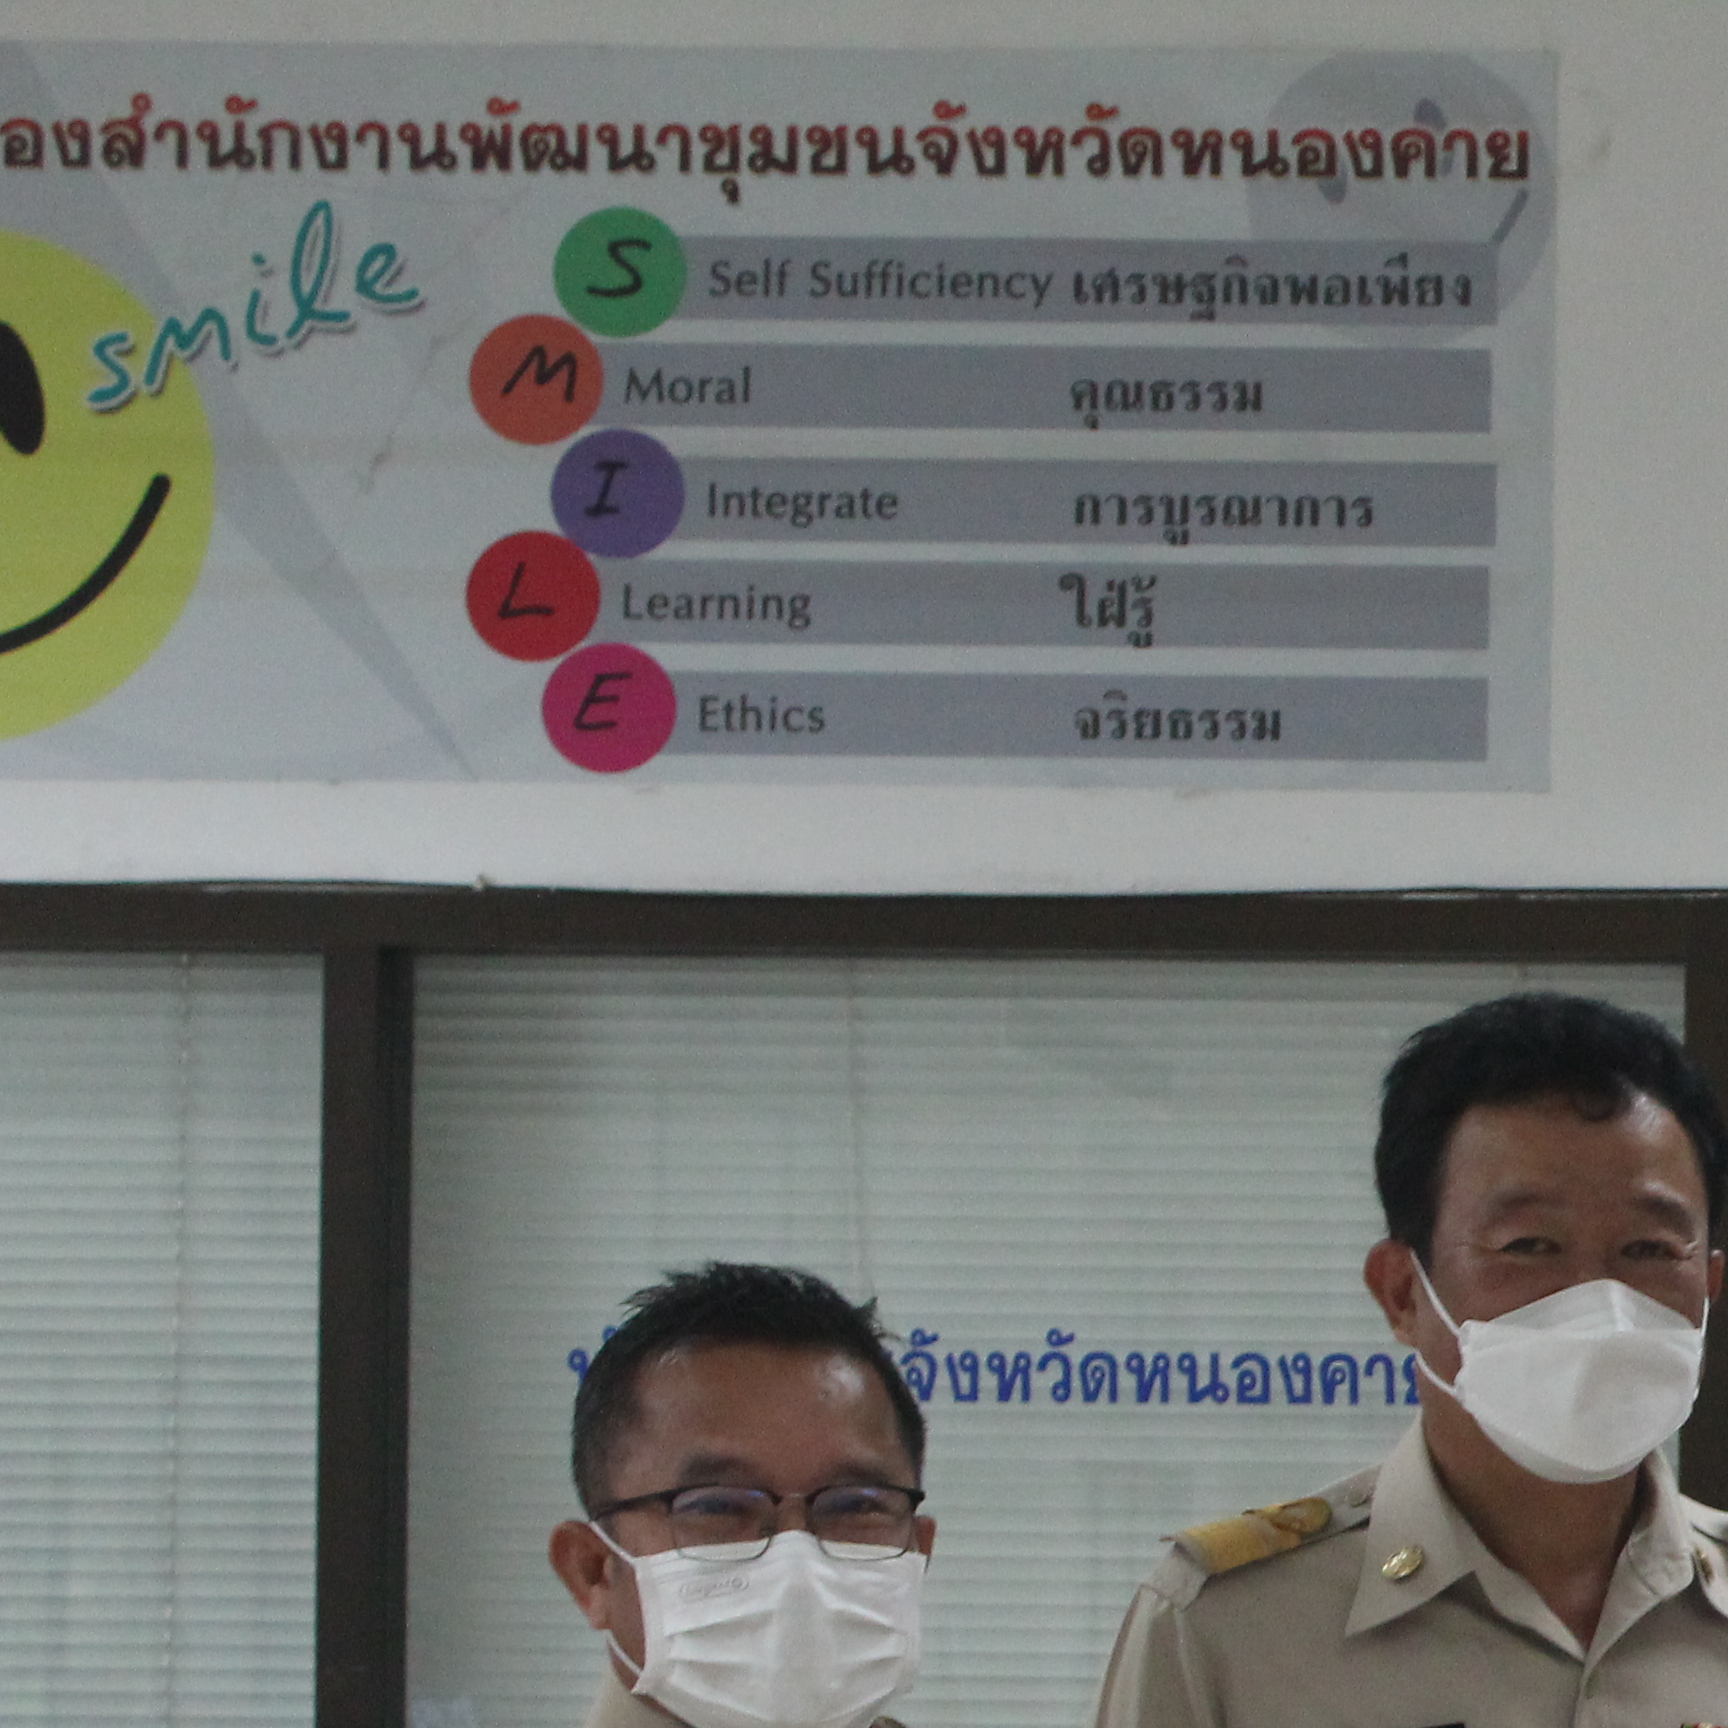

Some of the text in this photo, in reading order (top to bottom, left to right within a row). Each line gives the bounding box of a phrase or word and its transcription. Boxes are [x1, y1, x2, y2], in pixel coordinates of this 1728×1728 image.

[587, 238, 652, 298] S
[708, 251, 1473, 322] Self Sufficiency เศรษฐกิจพอเพียง
[87, 200, 421, 408] smile
[502, 345, 577, 403] M
[623, 366, 1264, 431] Moral คุณธรรม
[584, 460, 629, 517] I
[706, 483, 1374, 546] Integrate การบูรณาการ
[497, 561, 556, 619] L
[622, 583, 812, 631] Learning
[573, 672, 633, 731] E
[698, 689, 1282, 741] Ethics จริยธรรม
